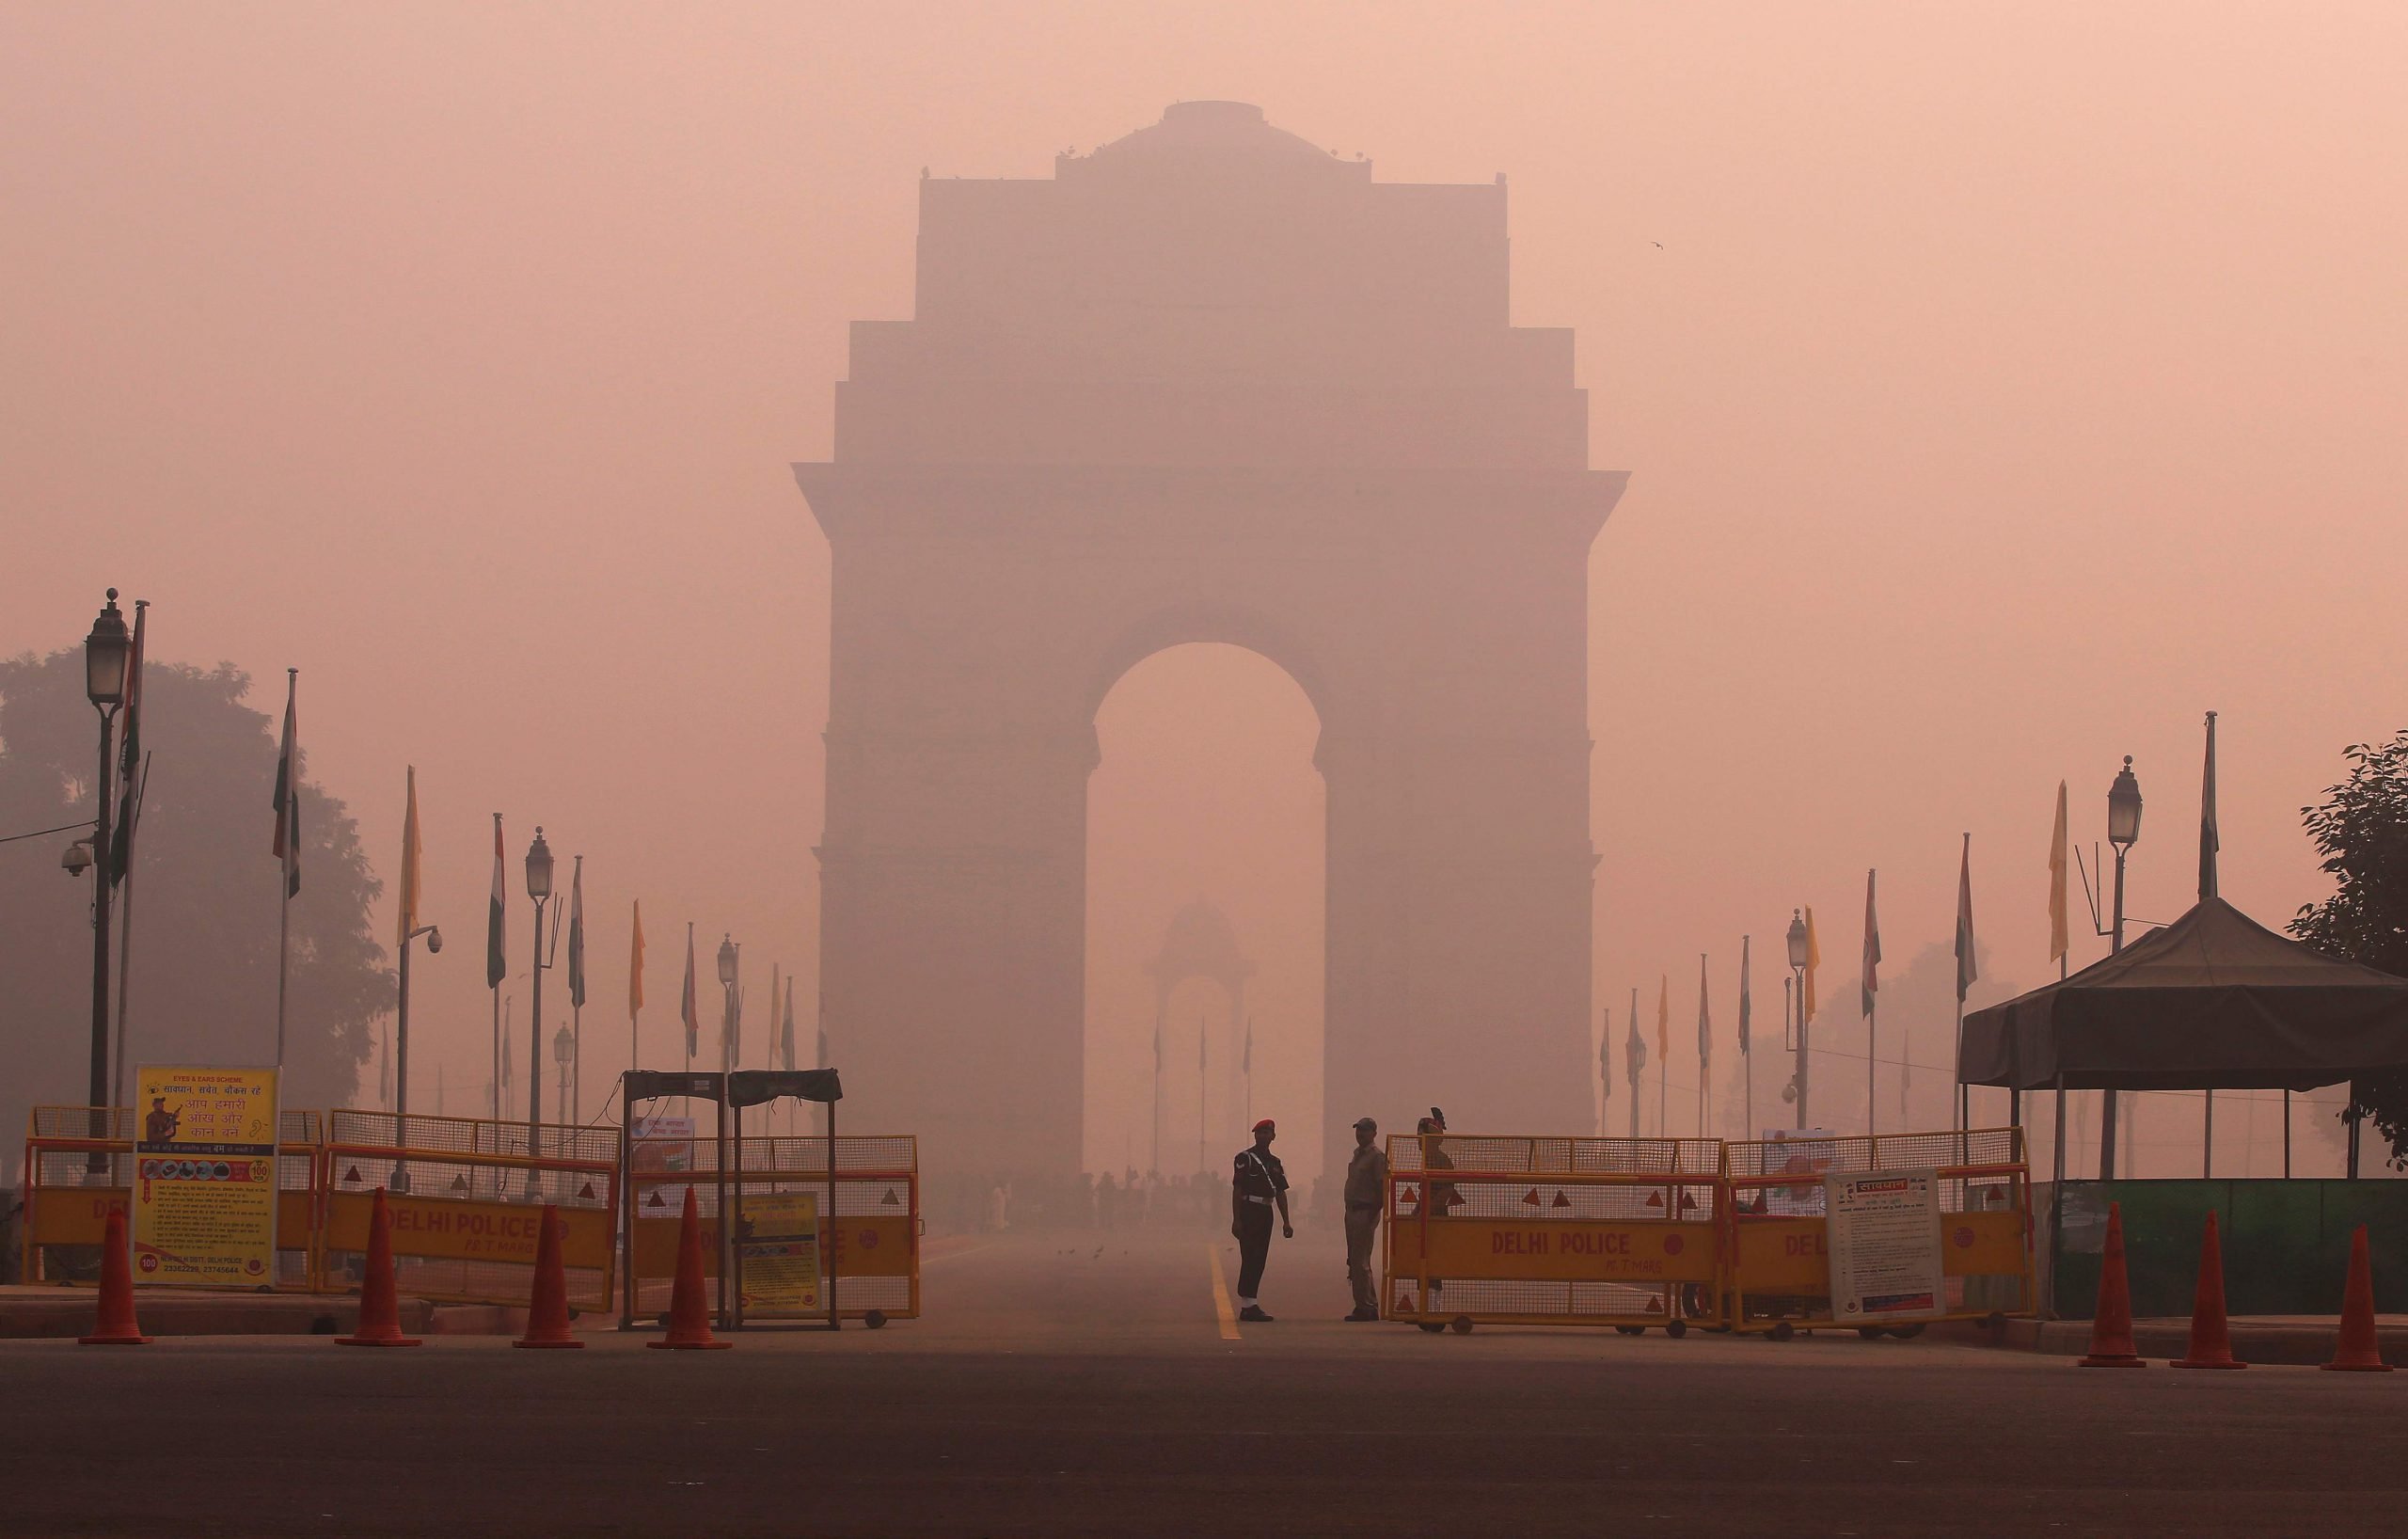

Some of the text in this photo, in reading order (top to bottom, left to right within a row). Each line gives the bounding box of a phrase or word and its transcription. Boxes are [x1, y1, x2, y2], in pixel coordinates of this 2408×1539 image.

[184, 1098, 246, 1110] आप हमारी
[221, 1111, 243, 1125] और
[190, 1128, 214, 1137] कान
[251, 1166, 267, 1176] 100
[457, 1213, 537, 1239] POLICE
[1492, 1231, 1631, 1255] DELHI POLICE
[142, 1259, 156, 1268] 100
